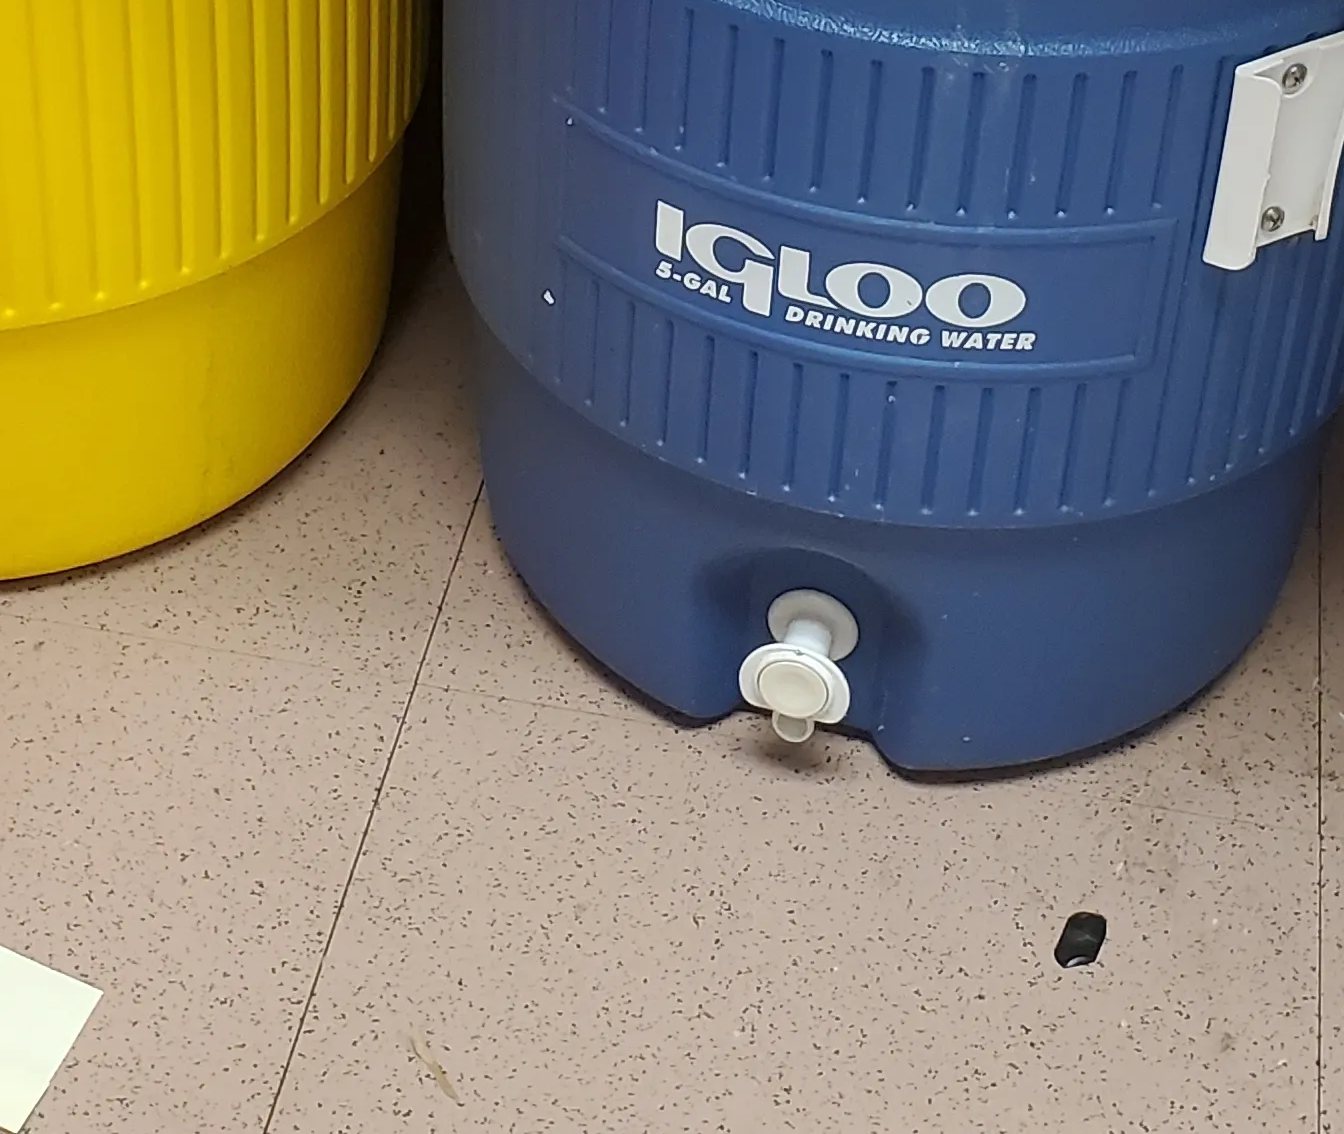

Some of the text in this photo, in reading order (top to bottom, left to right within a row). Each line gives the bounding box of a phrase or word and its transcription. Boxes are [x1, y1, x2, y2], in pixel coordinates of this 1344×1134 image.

[655, 200, 1027, 328] IGLOO
[655, 260, 1036, 350] 5-GAL DRINKING WATER
